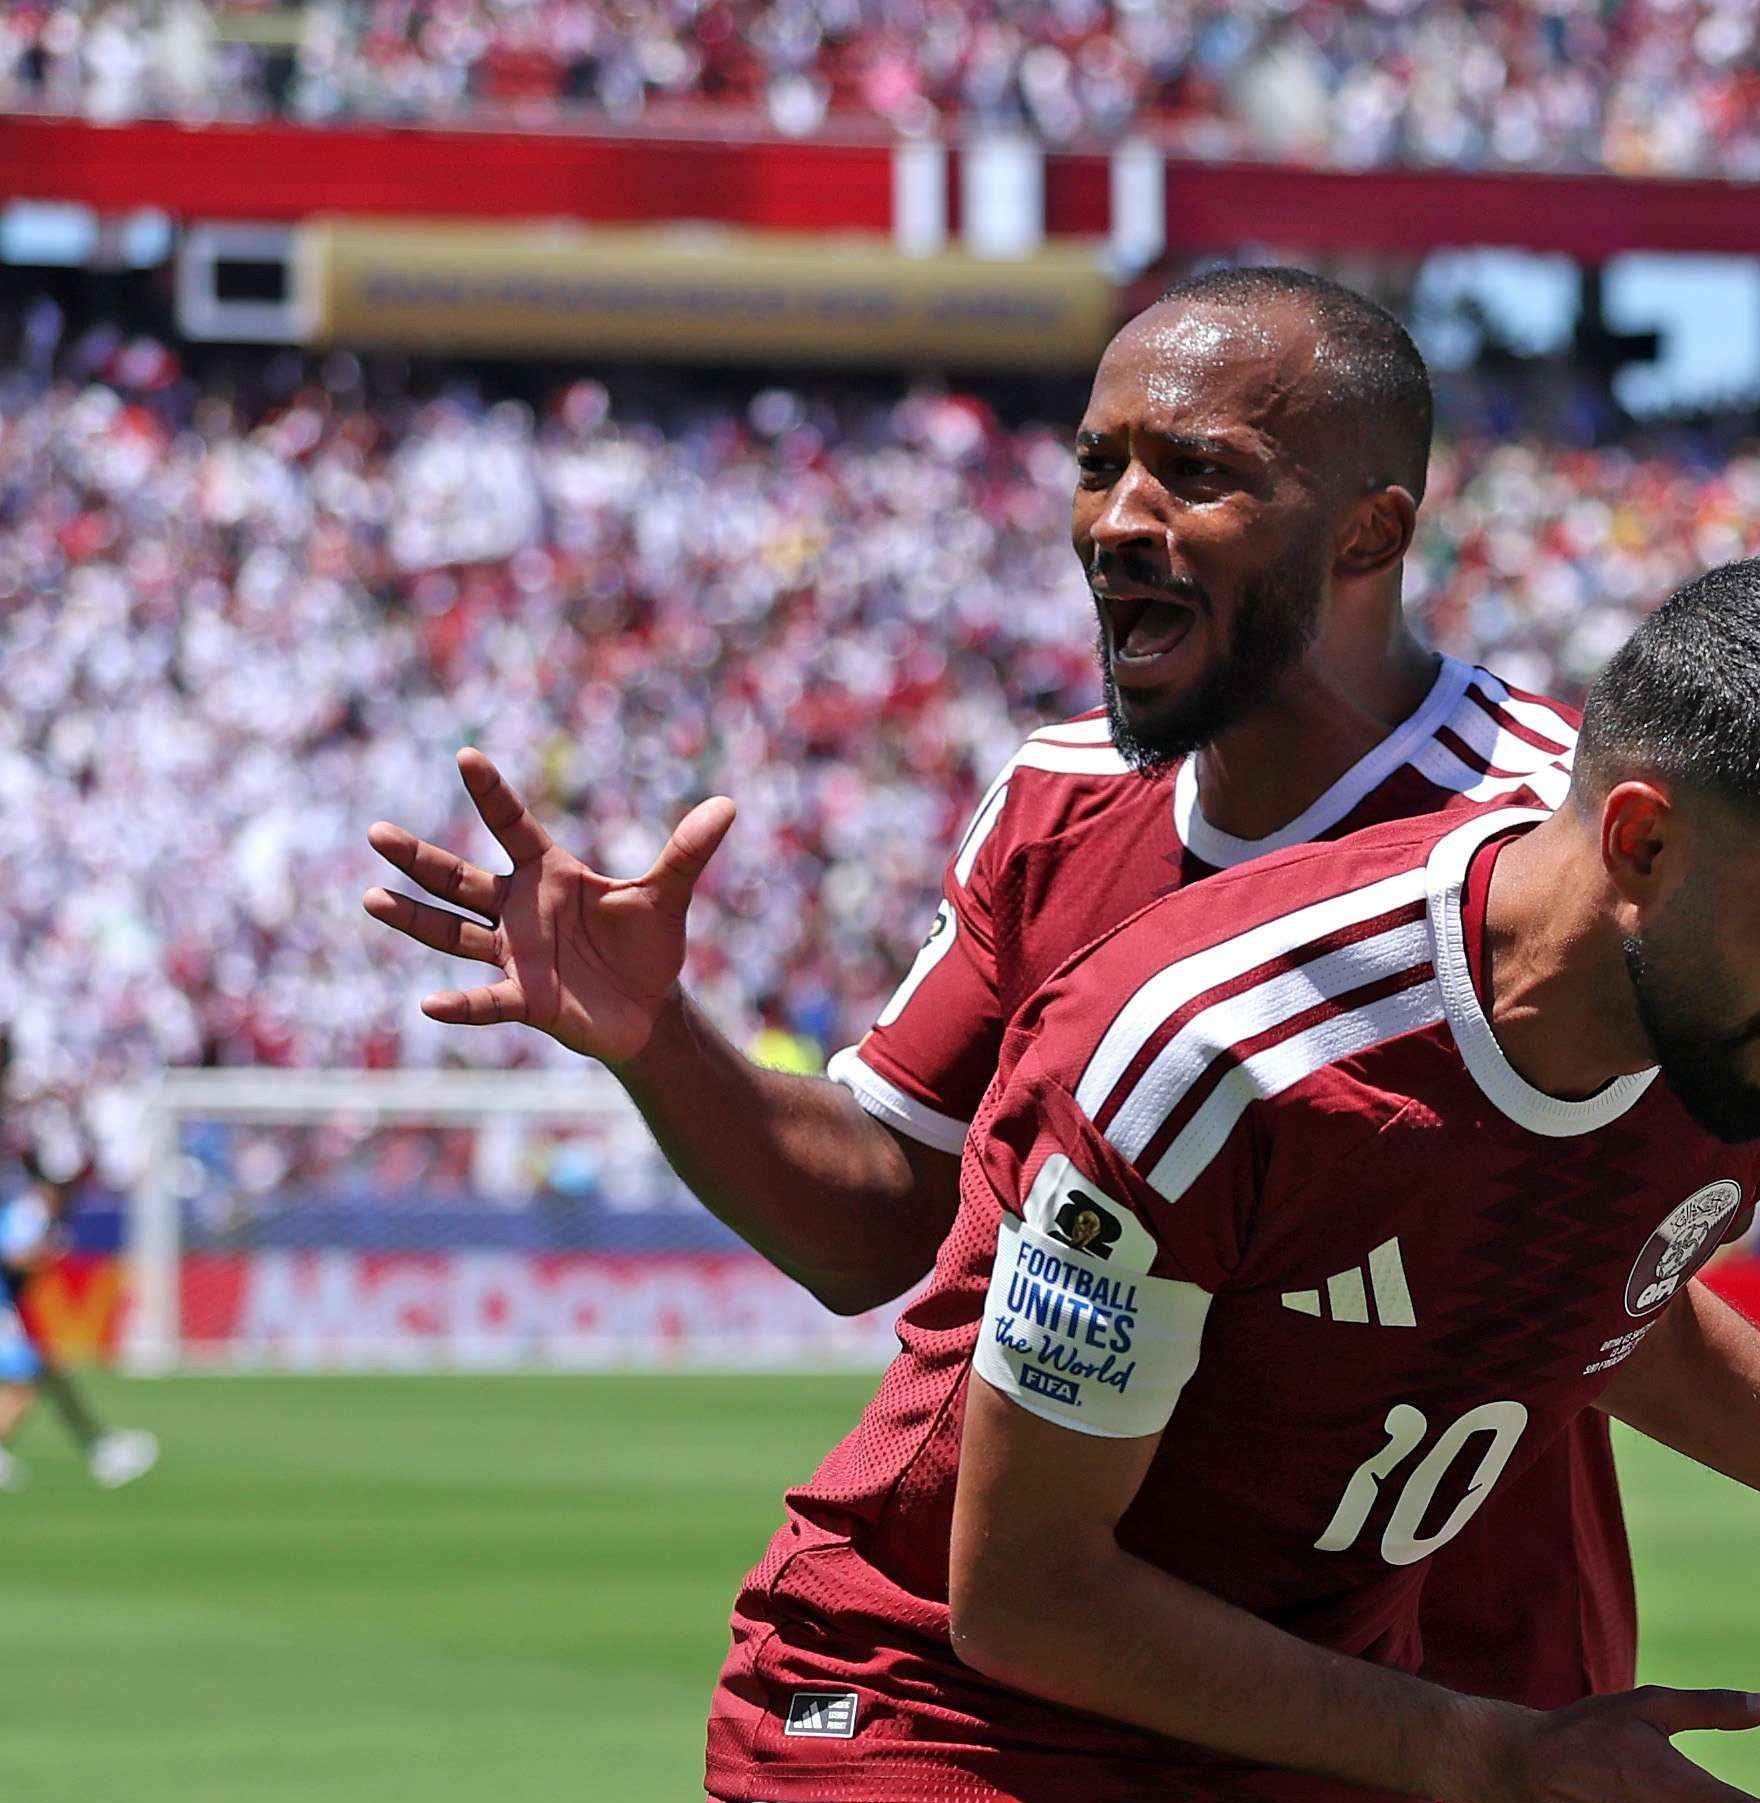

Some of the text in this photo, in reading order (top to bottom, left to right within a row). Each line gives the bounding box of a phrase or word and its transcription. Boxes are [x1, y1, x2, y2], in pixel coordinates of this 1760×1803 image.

[1007, 1273, 1135, 1352] UNITES
[1016, 1241, 1138, 1313] FOOTBALL
[995, 1315, 1136, 1393] the World
[1025, 1368, 1074, 1398] FIFA
[1314, 1401, 1528, 1565] 10
